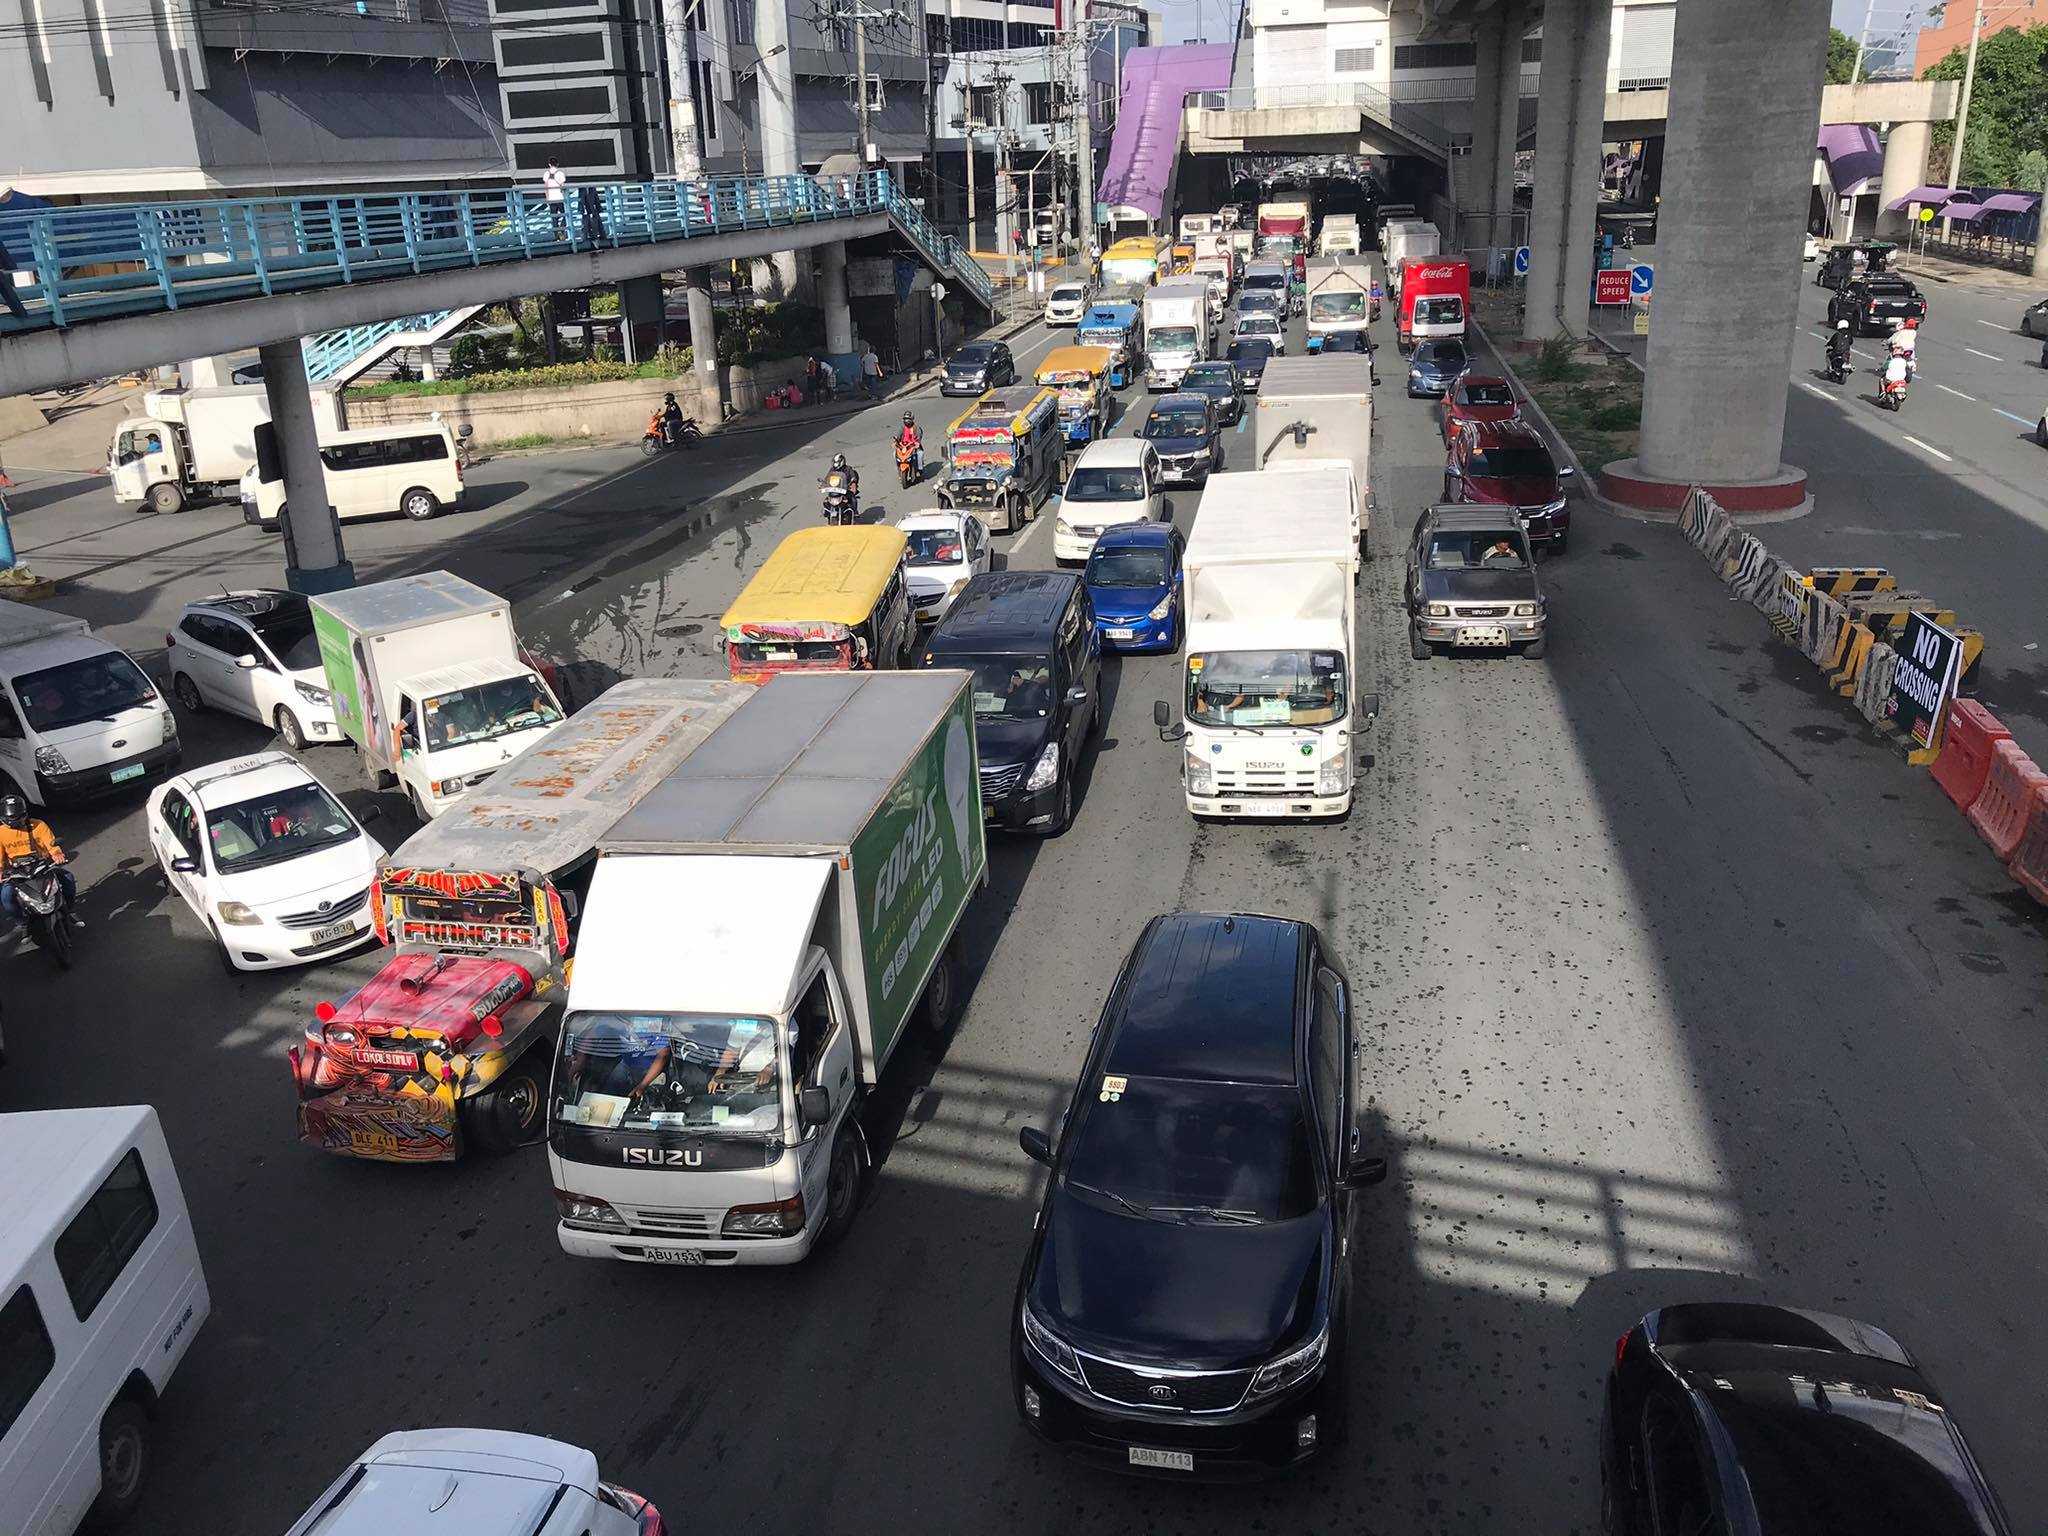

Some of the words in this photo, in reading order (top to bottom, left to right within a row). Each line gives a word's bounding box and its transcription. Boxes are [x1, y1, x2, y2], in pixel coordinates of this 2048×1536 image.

[1600, 277, 1629, 285] REDUCE
[1602, 287, 1625, 296] SPEED
[1912, 624, 1940, 669] NO
[1894, 656, 1939, 713] CROSSING
[1245, 761, 1285, 769] ISUZU
[872, 783, 938, 933] FOCUS
[921, 837, 943, 888] LED
[403, 920, 535, 950] FRANCIS
[355, 1133, 373, 1146] DLE
[377, 1135, 395, 1147] 411
[622, 1147, 702, 1166] ISUZU
[646, 1250, 673, 1262] ABU
[675, 1251, 702, 1264] 1531
[1152, 1388, 1173, 1398] KIA
[1131, 1449, 1158, 1462] ABN
[1162, 1452, 1192, 1467] 7113
